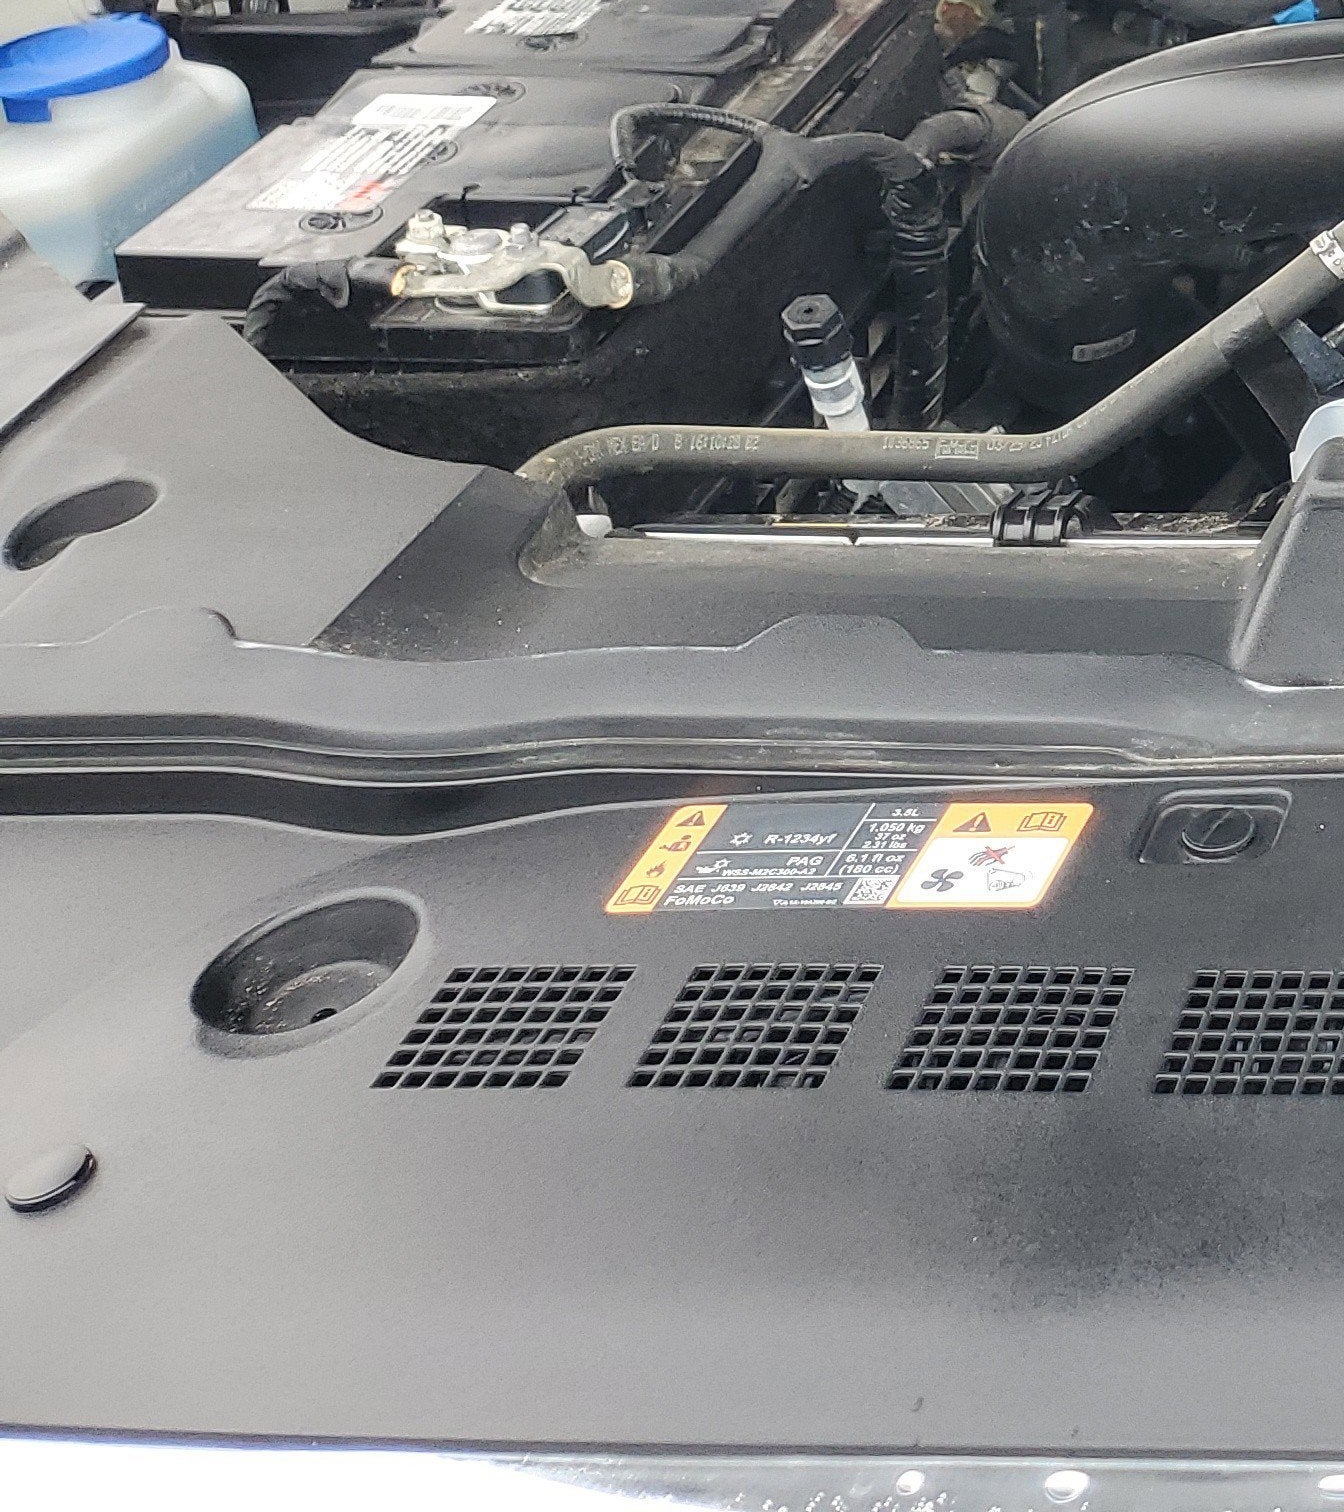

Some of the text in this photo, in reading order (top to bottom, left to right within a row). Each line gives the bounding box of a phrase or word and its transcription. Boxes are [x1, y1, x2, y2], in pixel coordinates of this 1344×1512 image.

[869, 822, 926, 834] 1.050 kg
[764, 833, 839, 846] R-1234yf
[890, 833, 907, 841] oz
[862, 841, 907, 849] 2.31 lbs
[786, 856, 825, 866] PAG
[846, 853, 906, 863] 6.1 fl oz
[874, 864, 899, 875] cc)
[674, 884, 706, 894] SAE
[711, 883, 746, 893] J639
[663, 894, 735, 906] FoMoCo
